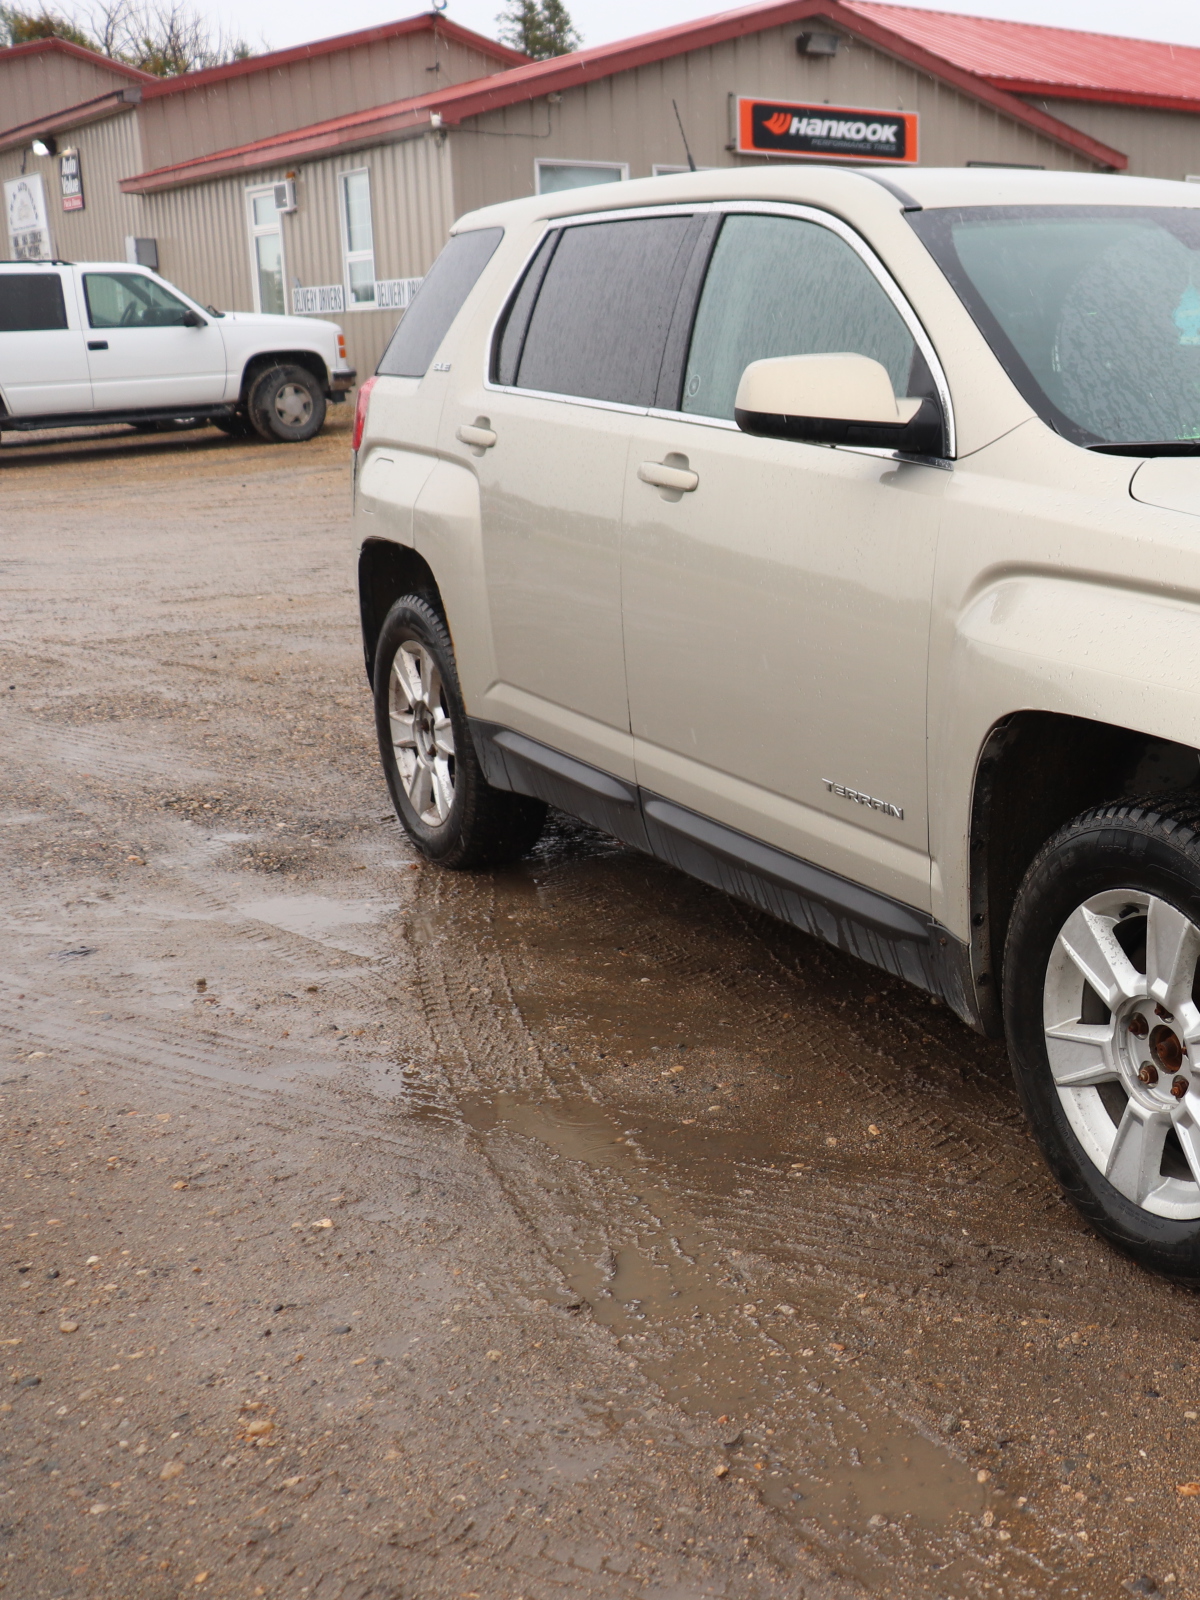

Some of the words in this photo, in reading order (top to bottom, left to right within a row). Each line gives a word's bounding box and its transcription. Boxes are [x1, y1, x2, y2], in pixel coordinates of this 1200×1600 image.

[811, 138, 872, 150] PERFORMANCE
[874, 143, 897, 152] TIRES
[62, 156, 76, 175] Auto
[61, 175, 79, 194] Value
[293, 288, 318, 313] DELIVERY
[319, 286, 342, 311] DRIVERS
[376, 281, 405, 308] DELIVERY
[822, 778, 904, 820] TERRAIN
